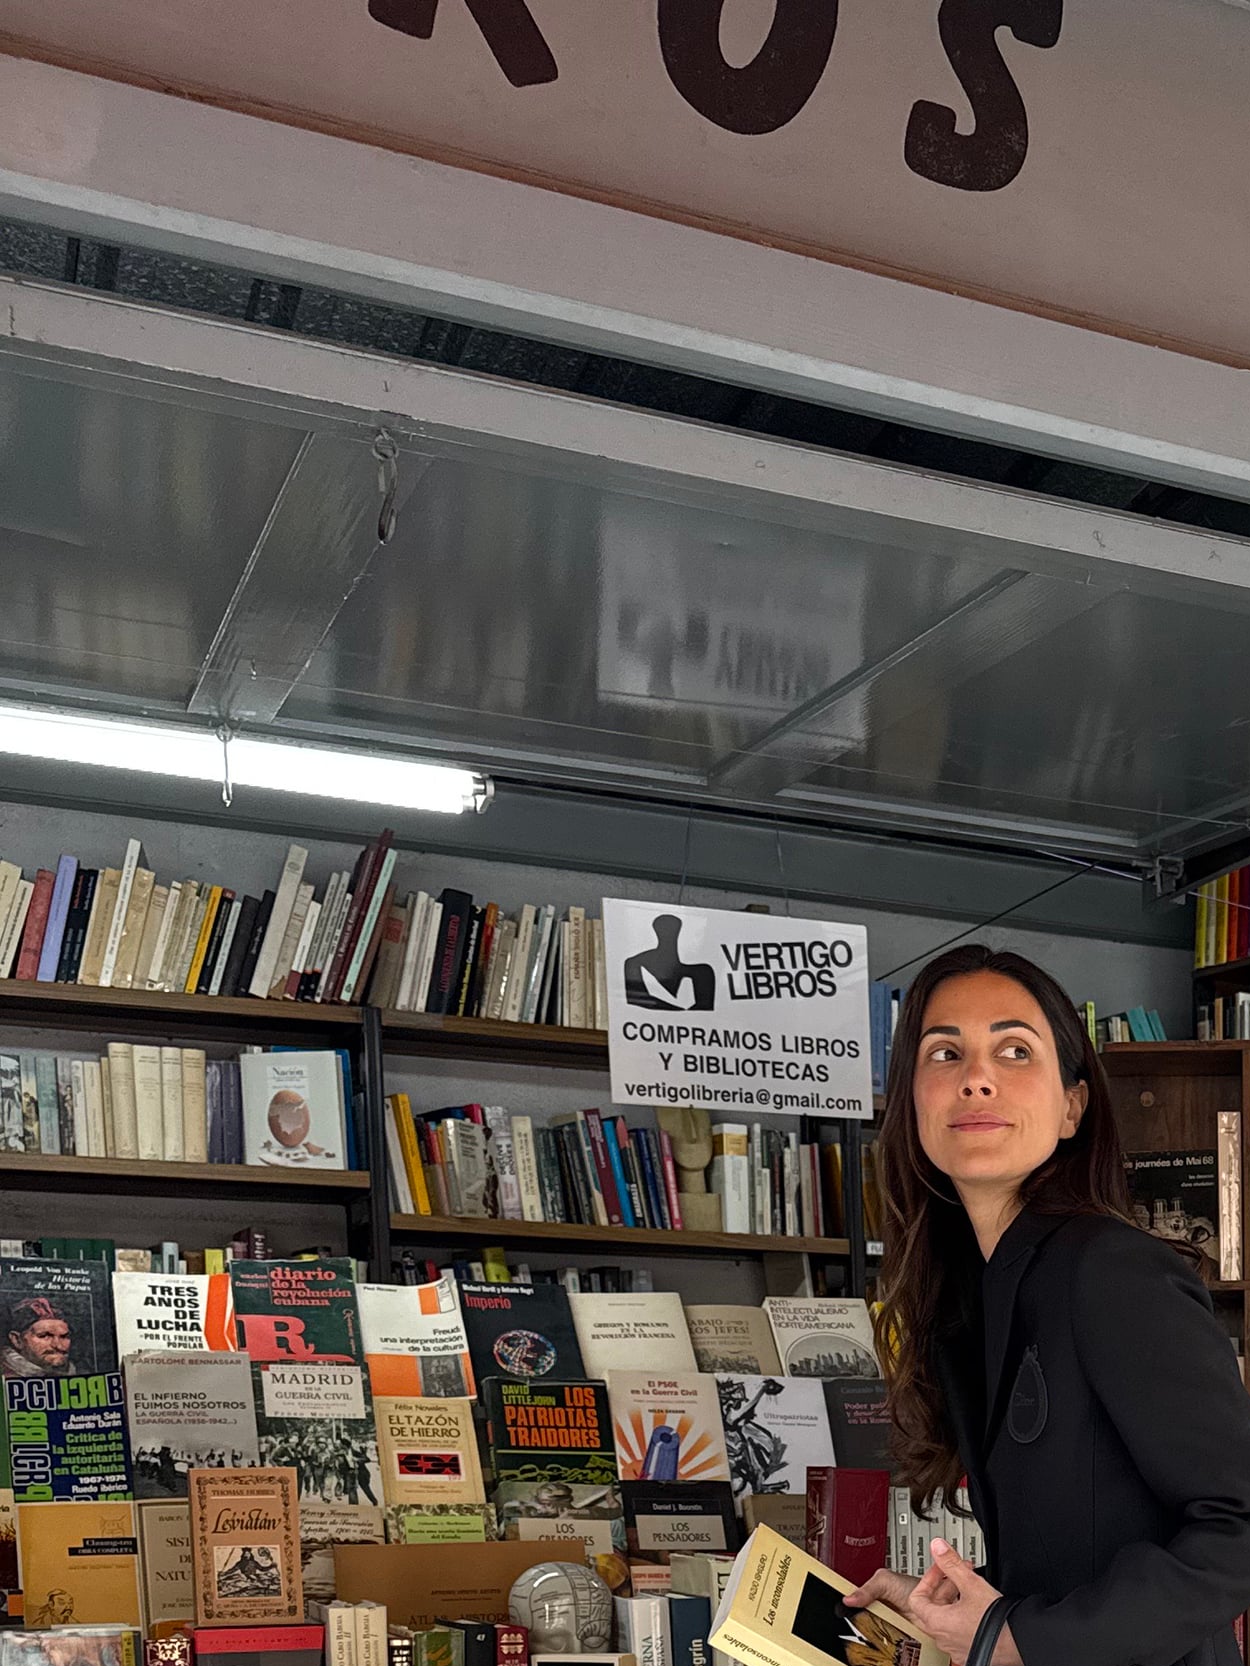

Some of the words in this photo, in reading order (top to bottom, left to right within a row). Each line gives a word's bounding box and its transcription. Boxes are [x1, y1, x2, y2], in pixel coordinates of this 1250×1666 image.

[720, 940, 853, 972] VERTIGO
[727, 969, 838, 1001] LIBROS
[622, 1021, 773, 1052] COMPRAMOS
[781, 1034, 860, 1058] LIBROS
[658, 1052, 673, 1071] Y
[683, 1054, 830, 1083] BIBLIOTECAS
[625, 1081, 863, 1112] vertigolibreria@gmail.com
[270, 1266, 337, 1281] diario
[271, 1280, 290, 1289] de
[291, 1280, 307, 1289] la
[147, 1285, 199, 1298] TRES
[272, 1287, 352, 1299] revolución
[273, 1297, 331, 1306] cubana
[464, 1293, 512, 1311] Imperio
[174, 1309, 200, 1321] DE
[786, 1314, 799, 1322] LA
[799, 1314, 820, 1323] VIDA
[136, 1319, 203, 1333] LUCHA
[773, 1321, 856, 1330] NORTEAMERICANA
[379, 1336, 398, 1344] una
[399, 1335, 463, 1345] interpretación
[432, 1343, 464, 1352] cultura
[271, 1373, 354, 1386] MADRID
[133, 1392, 149, 1401] EL
[151, 1392, 207, 1401] INFIERNO
[275, 1392, 322, 1401] GUERRA
[324, 1392, 353, 1401] CIVIL
[501, 1385, 530, 1396] DAVID
[563, 1386, 596, 1407] LOS
[134, 1401, 179, 1410] FUIMOS
[182, 1401, 247, 1410] NOSOTROS
[503, 1395, 557, 1406] LITTLEJOHN
[69, 1413, 102, 1423] Antonio
[388, 1415, 404, 1426] EL
[405, 1413, 459, 1426] TAZÓN
[504, 1406, 599, 1428] PATRIOTAS
[62, 1420, 96, 1430] Eduardo
[107, 1430, 123, 1441] de
[390, 1426, 410, 1438] DE
[410, 1427, 461, 1438] HIERRO
[506, 1427, 601, 1449] TRAIDORES
[51, 1444, 65, 1455] la
[66, 1441, 124, 1456] izquierda
[60, 1452, 125, 1465] autoritaria
[53, 1466, 70, 1476] en
[71, 1484, 98, 1495] Ruedo
[555, 1523, 576, 1534] LOS
[670, 1522, 690, 1532] LOS
[652, 1531, 711, 1543] PENSADORES
[762, 1606, 778, 1627] Los
[770, 1553, 793, 1608] inconsolables
